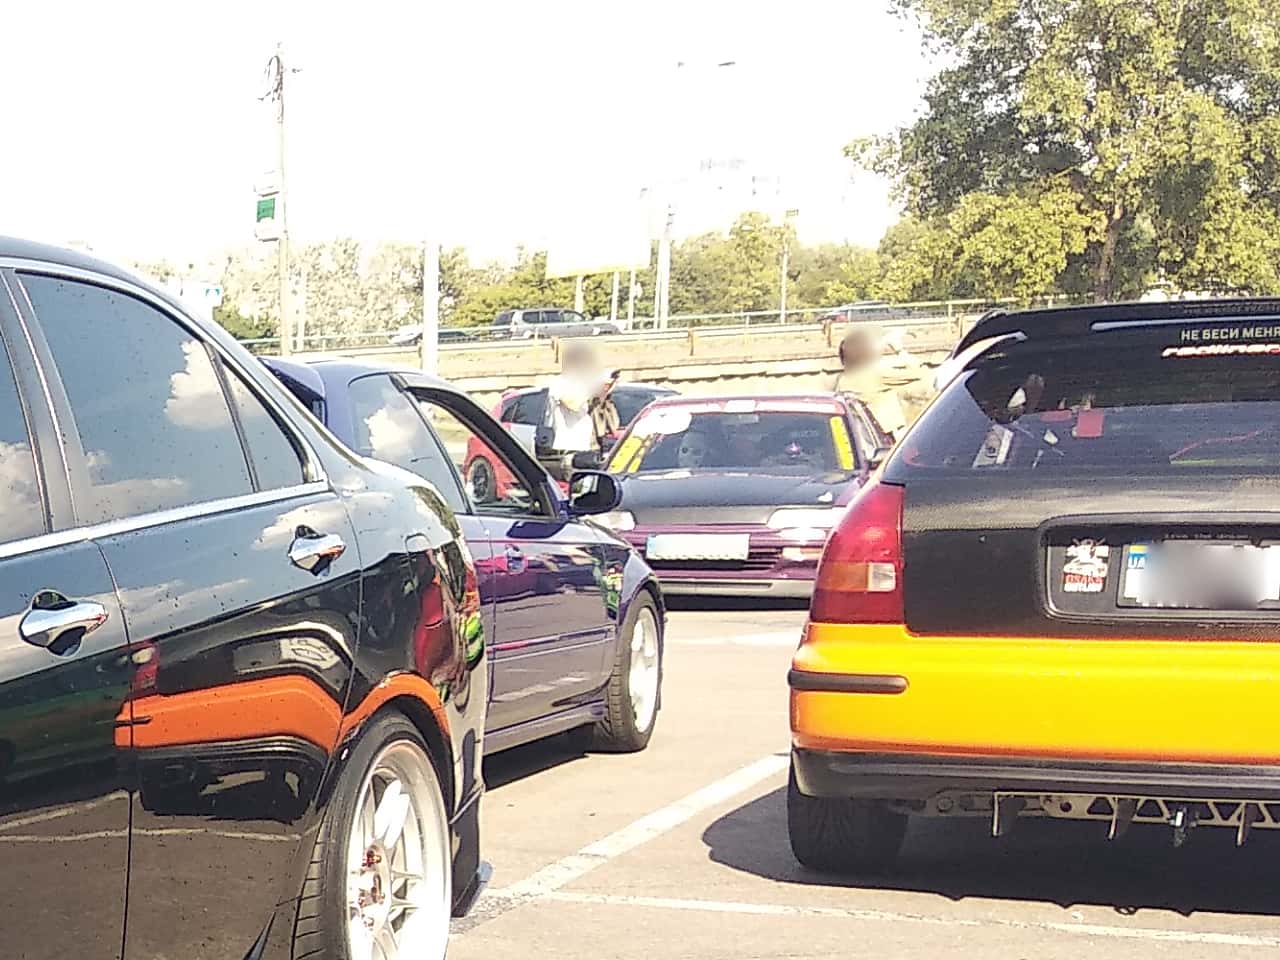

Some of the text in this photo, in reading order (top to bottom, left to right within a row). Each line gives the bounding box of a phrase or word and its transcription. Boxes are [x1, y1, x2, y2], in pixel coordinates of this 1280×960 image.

[1181, 329, 1200, 341] НЕ
[1202, 327, 1239, 340] БЕСИ
[1127, 554, 1146, 570] UA
